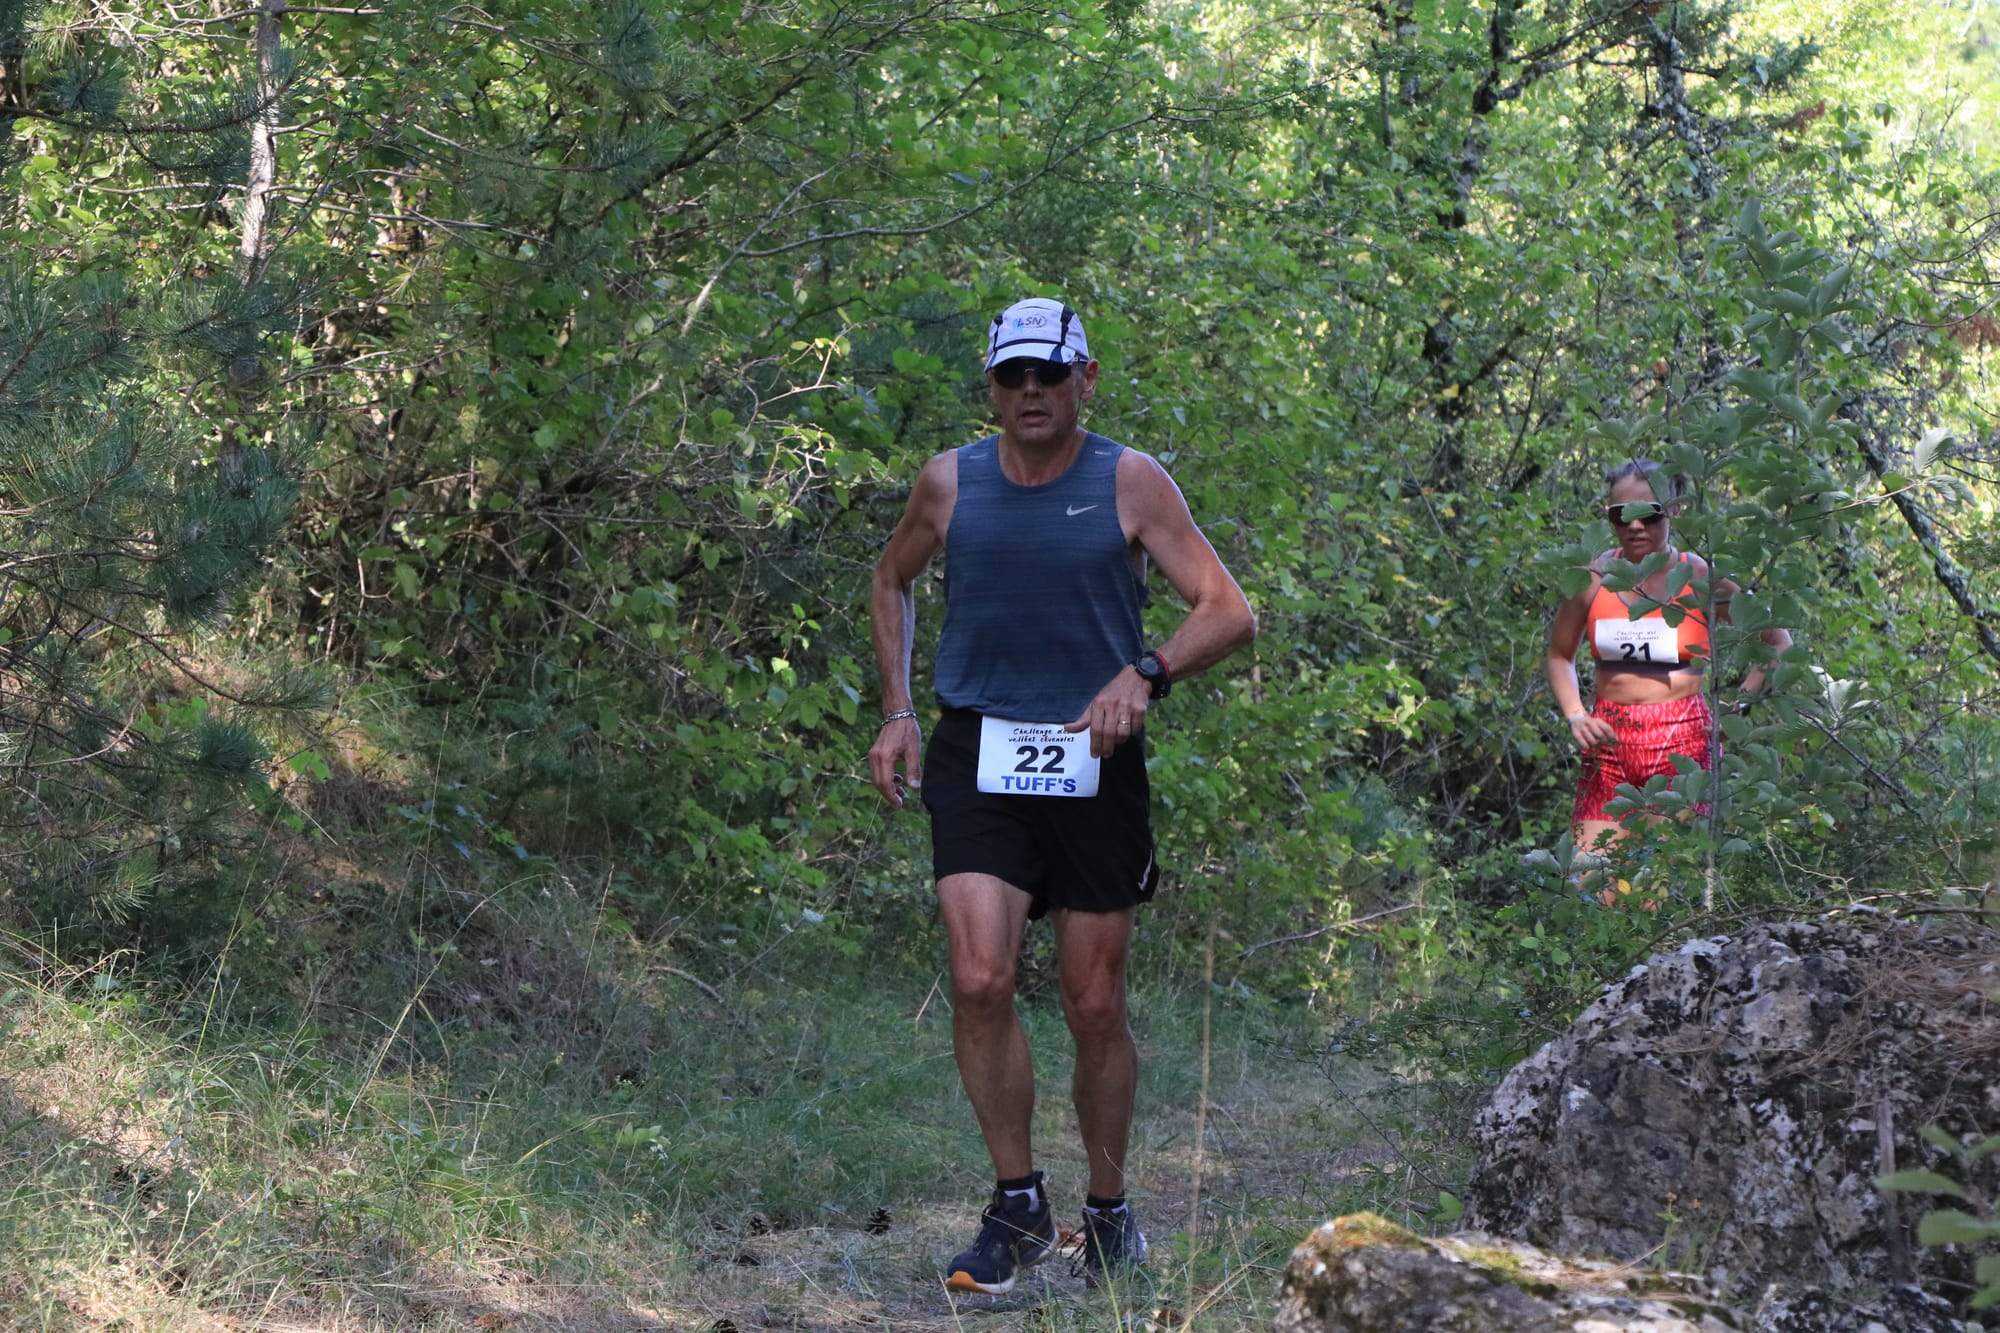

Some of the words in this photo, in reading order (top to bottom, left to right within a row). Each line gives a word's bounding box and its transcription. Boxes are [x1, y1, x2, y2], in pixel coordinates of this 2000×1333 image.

[1620, 642, 1651, 661] 21
[1013, 728, 1052, 737] Challenge
[1014, 745, 1065, 774] 22
[1001, 776, 1077, 793] TUFF'S
